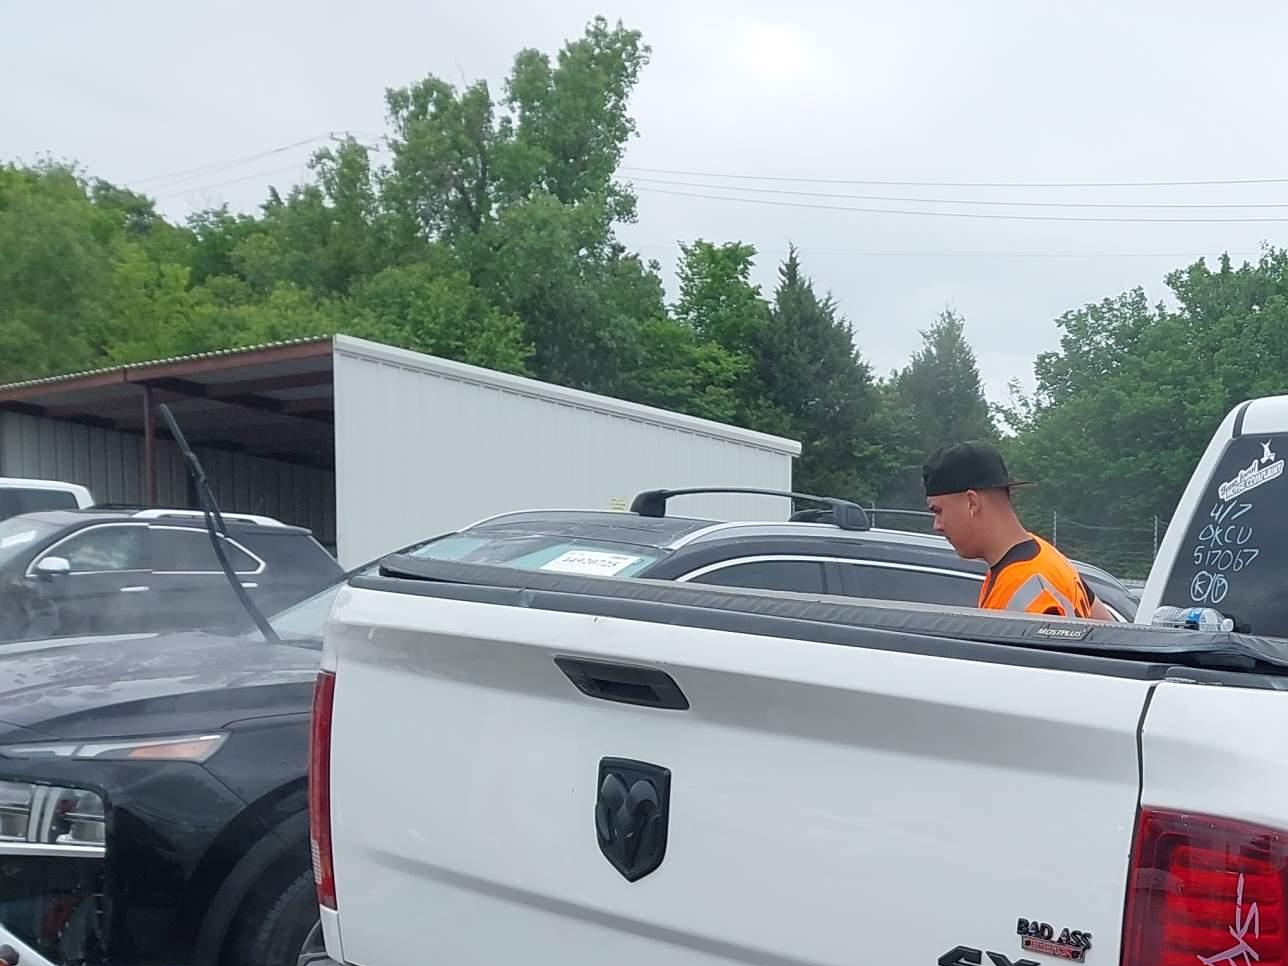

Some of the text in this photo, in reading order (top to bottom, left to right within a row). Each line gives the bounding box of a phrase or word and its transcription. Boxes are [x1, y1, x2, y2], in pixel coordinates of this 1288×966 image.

[1194, 546, 1259, 571] 517067
[1036, 628, 1082, 638] MOSTPLUS
[1016, 917, 1093, 951] BAD ASS
